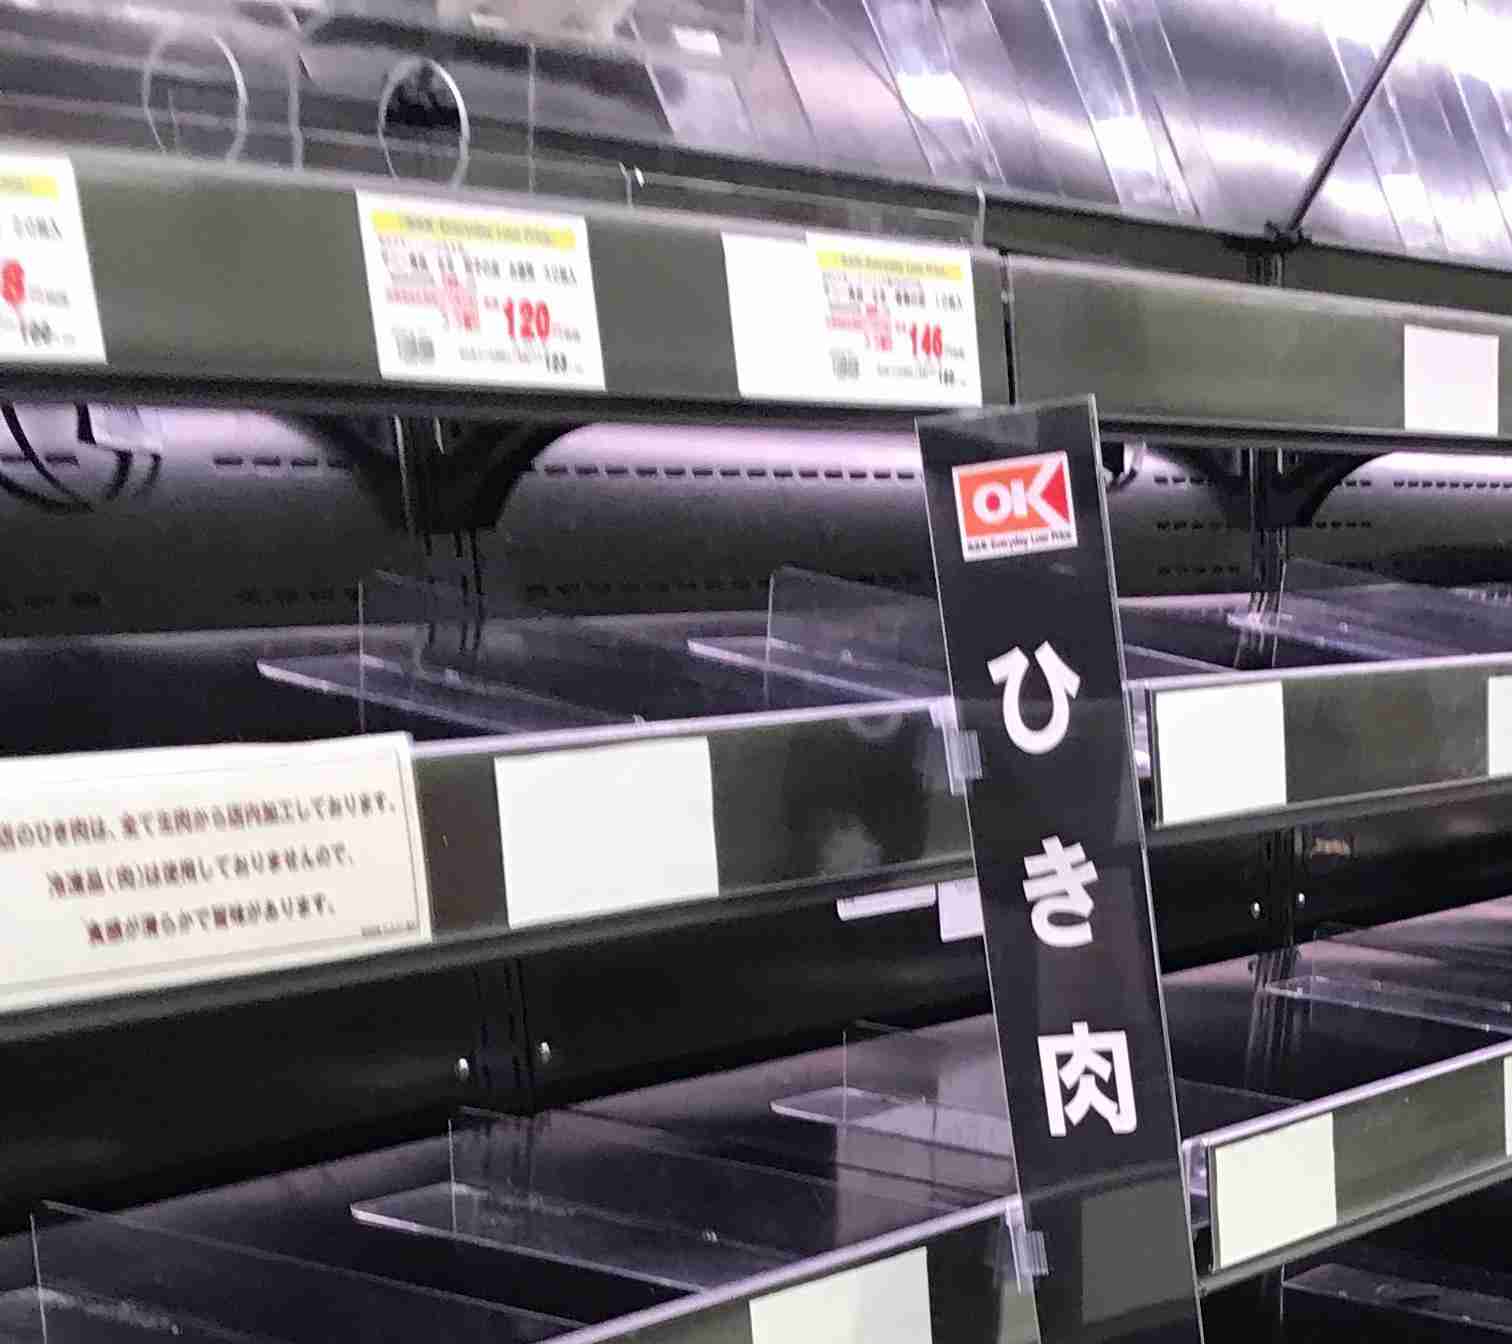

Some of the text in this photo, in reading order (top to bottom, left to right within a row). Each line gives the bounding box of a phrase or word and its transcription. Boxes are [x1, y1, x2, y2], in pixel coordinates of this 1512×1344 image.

[502, 297, 552, 346] 120
[972, 461, 1070, 526] OK
[987, 640, 1138, 1138] ひき肉
